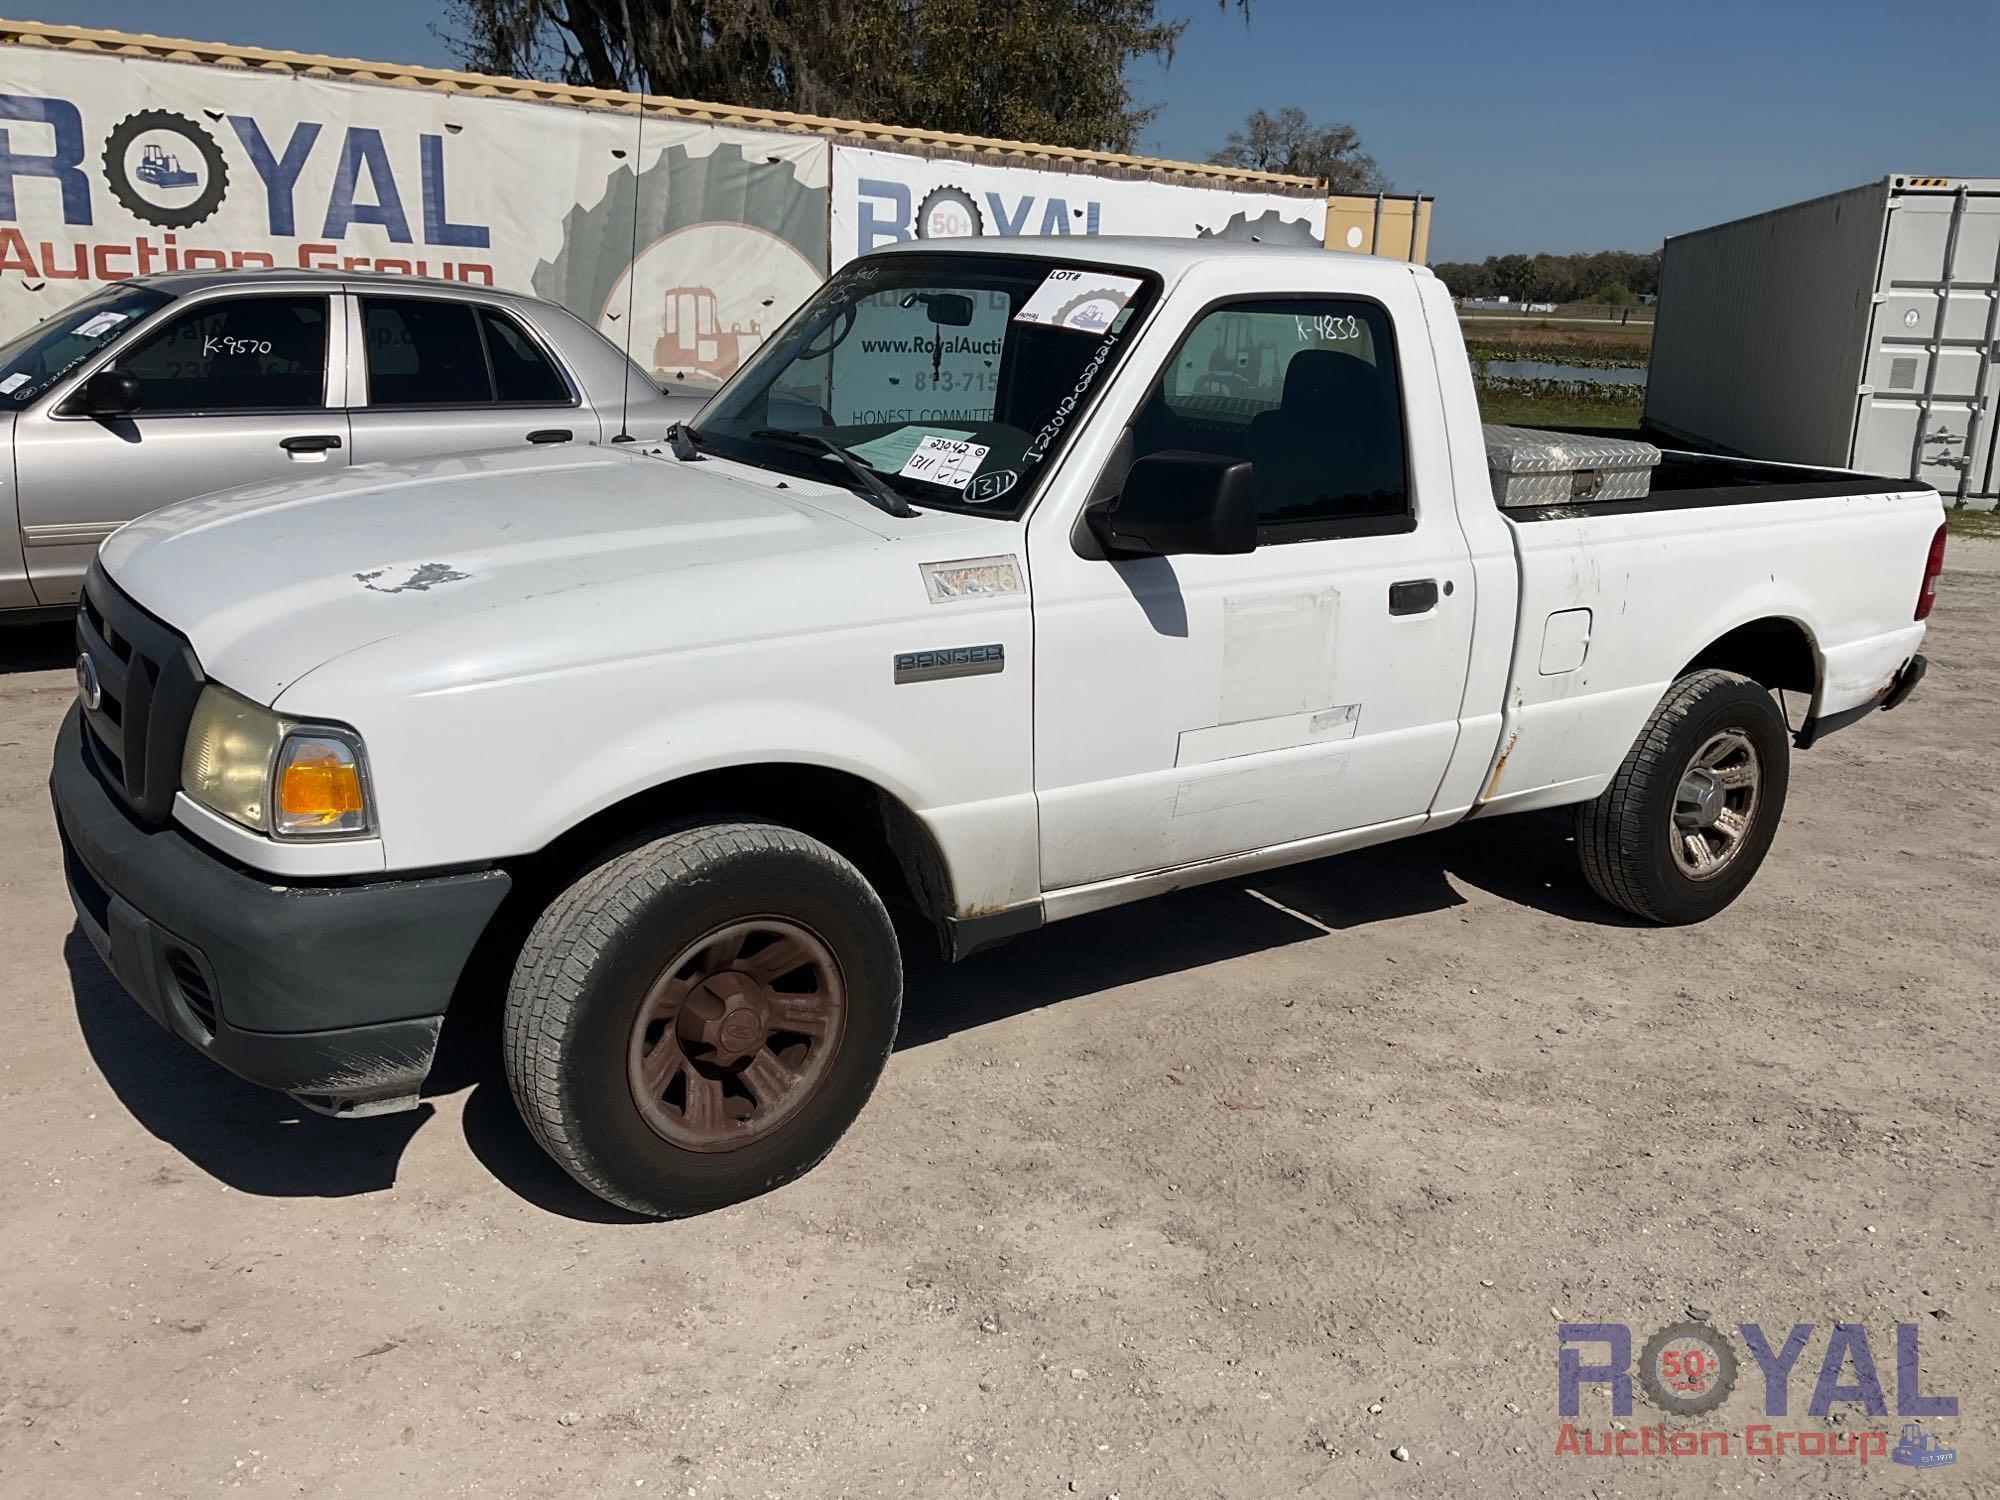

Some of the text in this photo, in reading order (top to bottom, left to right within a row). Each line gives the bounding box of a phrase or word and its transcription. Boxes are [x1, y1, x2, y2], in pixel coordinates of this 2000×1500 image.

[0, 94, 490, 248] ROYAL
[932, 212, 970, 235] 50+
[1049, 271, 1082, 281] LOT#
[203, 335, 272, 357] K-9570
[862, 336, 1002, 355] www.RoalAucti
[852, 409, 914, 425] HONEST
[931, 439, 970, 454] 23042
[909, 454, 935, 471] 1311
[971, 475, 1010, 500] 1311
[898, 648, 1003, 671] RANGER
